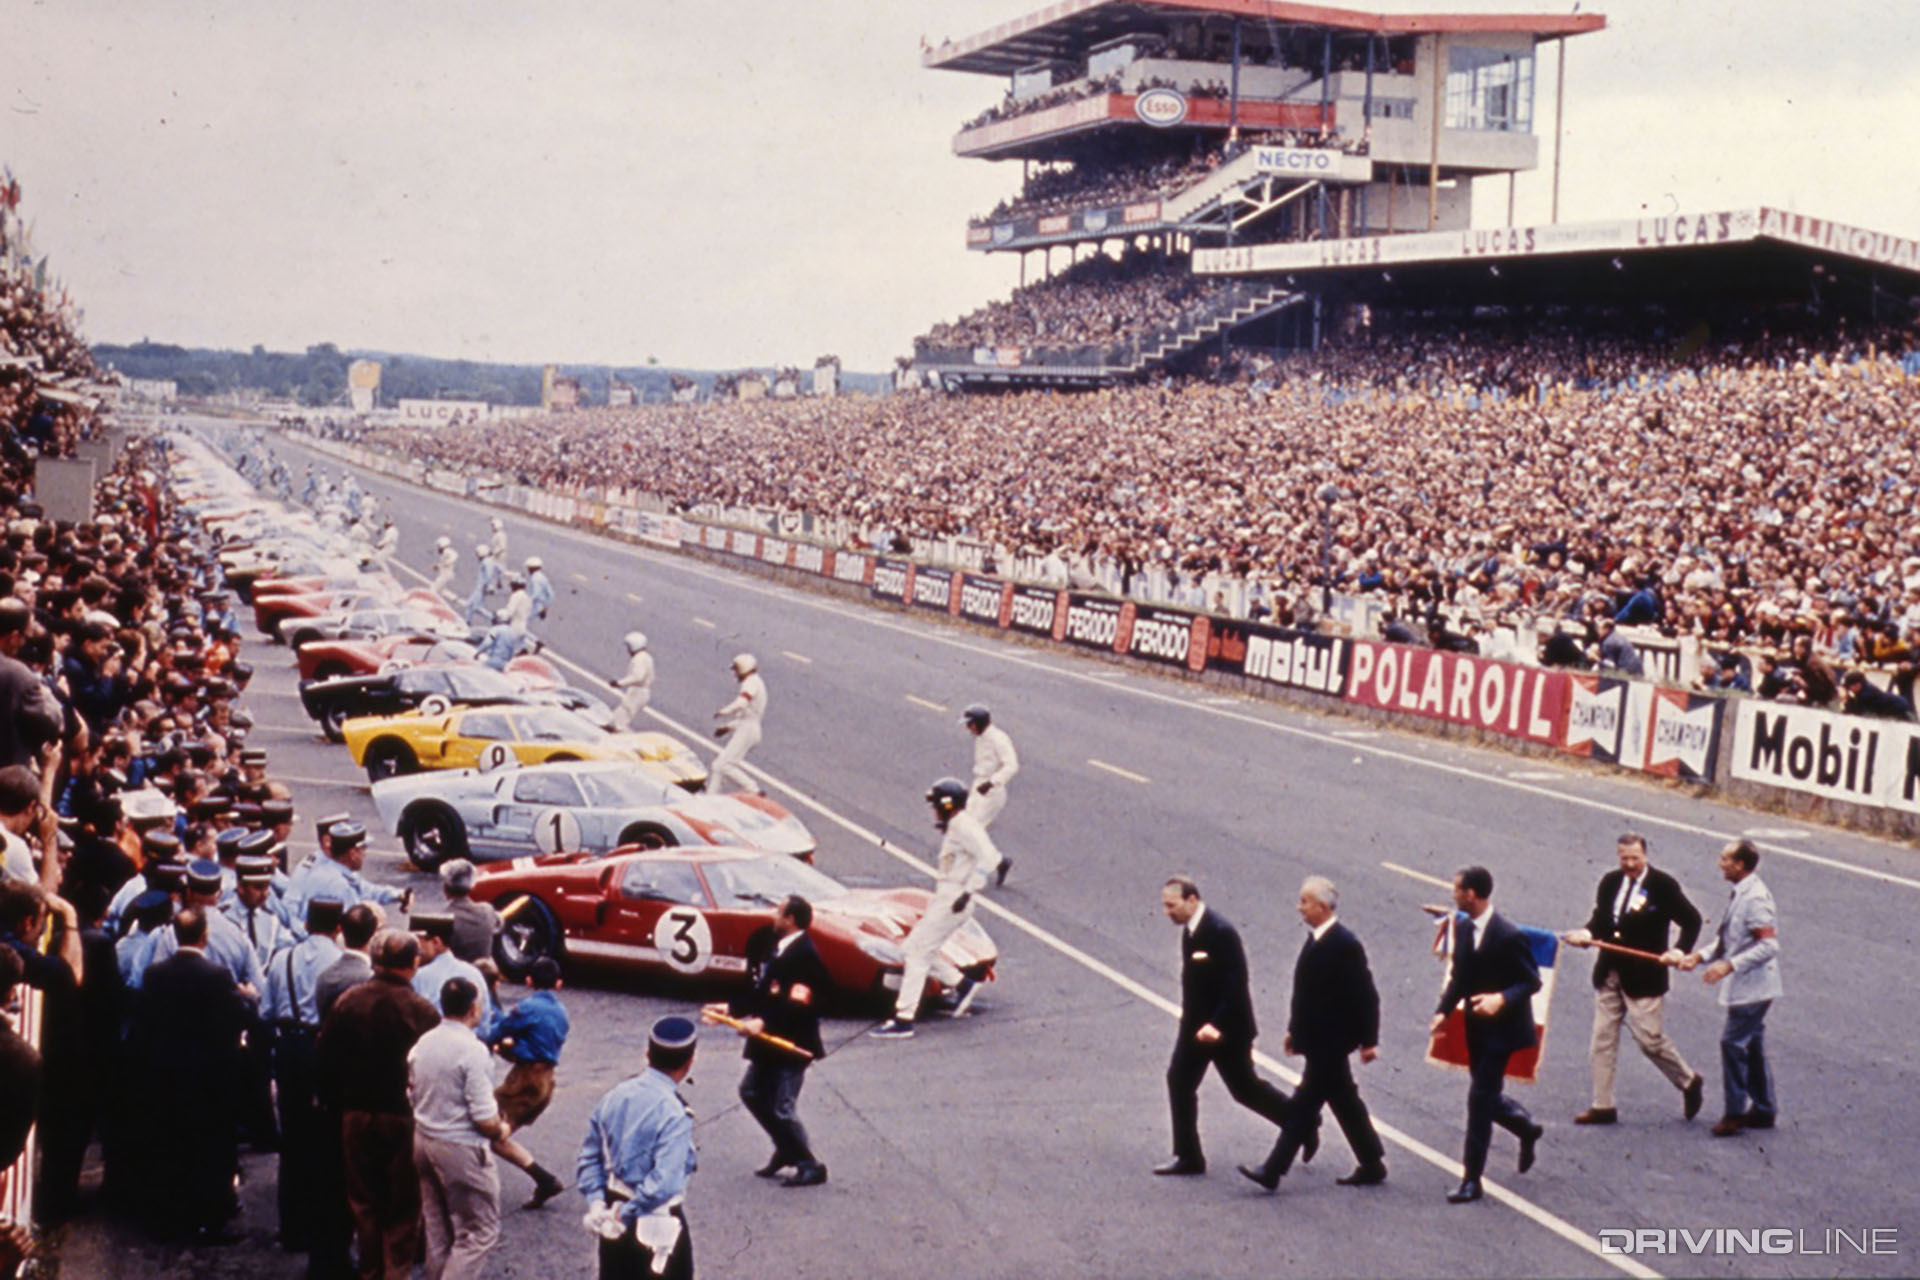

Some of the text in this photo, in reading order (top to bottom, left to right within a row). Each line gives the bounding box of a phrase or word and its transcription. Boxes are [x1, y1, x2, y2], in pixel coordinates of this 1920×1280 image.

[1147, 99, 1178, 115] Esso
[1258, 150, 1329, 169] NECTO
[1461, 227, 1536, 255] LUCAS
[1636, 212, 1732, 246] LUCAS
[1760, 207, 1920, 272] ALLINQUA
[1320, 239, 1381, 266] LUCAS
[406, 404, 480, 421] LUCAS
[961, 584, 1001, 619] FERODO
[1011, 593, 1054, 630] FERODO
[1066, 606, 1117, 645] FERODO
[1130, 619, 1190, 661] FERODO
[1349, 643, 1552, 738] POLAROIL
[1750, 710, 1880, 795] Mobil
[549, 812, 563, 854] 1
[670, 912, 699, 965] 3
